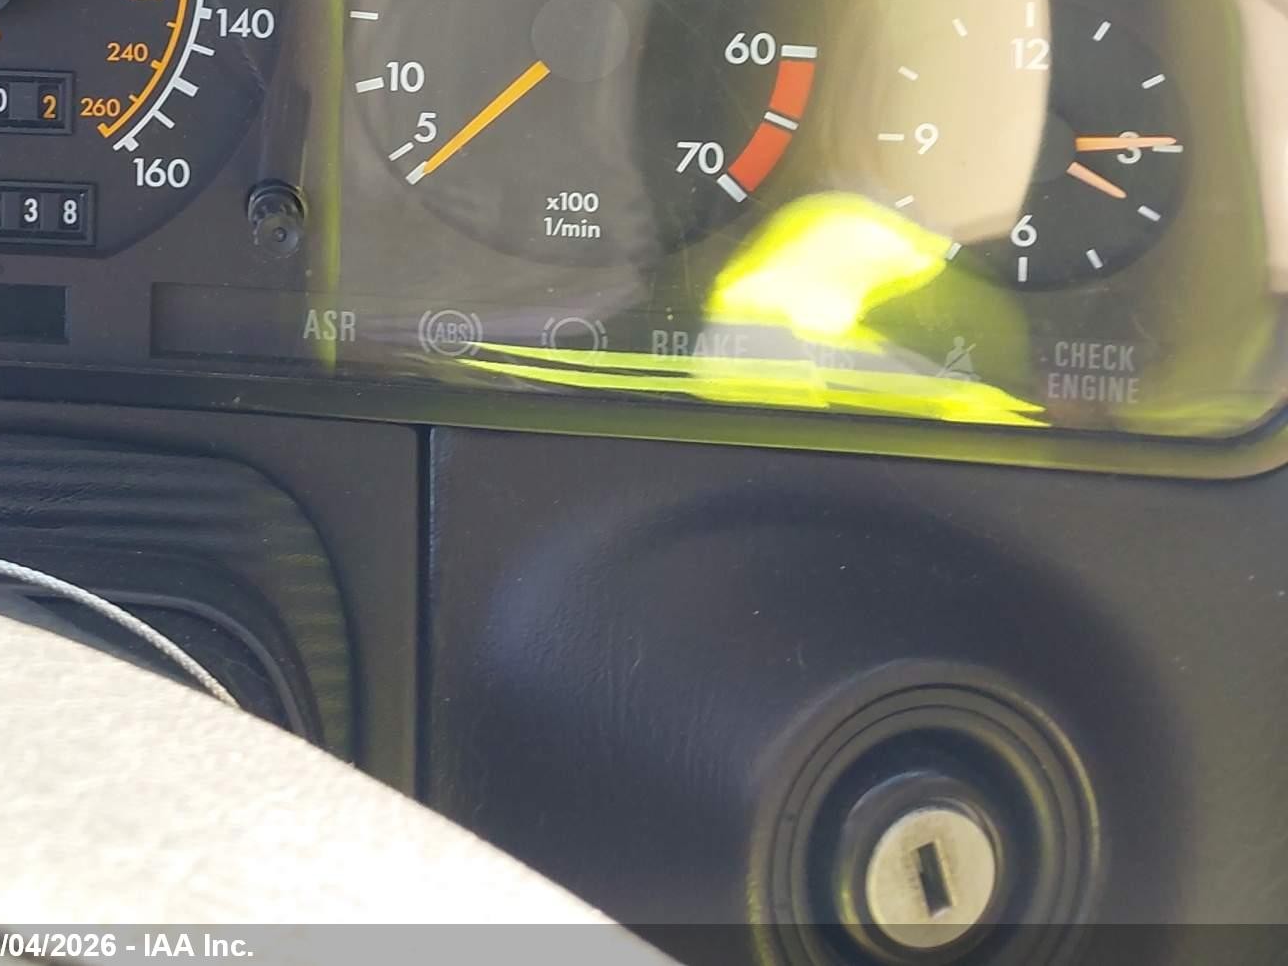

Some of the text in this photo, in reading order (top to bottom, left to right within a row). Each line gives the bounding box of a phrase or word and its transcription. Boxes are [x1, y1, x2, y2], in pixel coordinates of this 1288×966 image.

[216, 8, 275, 39] 140
[107, 42, 148, 62] 240
[724, 32, 776, 65] 60
[1011, 38, 1050, 70] 12
[386, 61, 425, 92] 10
[80, 97, 120, 117] 260
[414, 112, 437, 144] 5
[914, 123, 939, 155] 9
[133, 157, 191, 188] 160
[675, 141, 724, 175] 70
[546, 192, 599, 213] x100
[543, 216, 600, 238] 1/min
[1011, 214, 1038, 247] 6
[303, 309, 356, 342] ASR
[435, 322, 468, 343] ABS
[651, 329, 749, 358] BRAKE
[1055, 341, 1135, 372] CHECK
[1047, 372, 1139, 404] ENGINE
